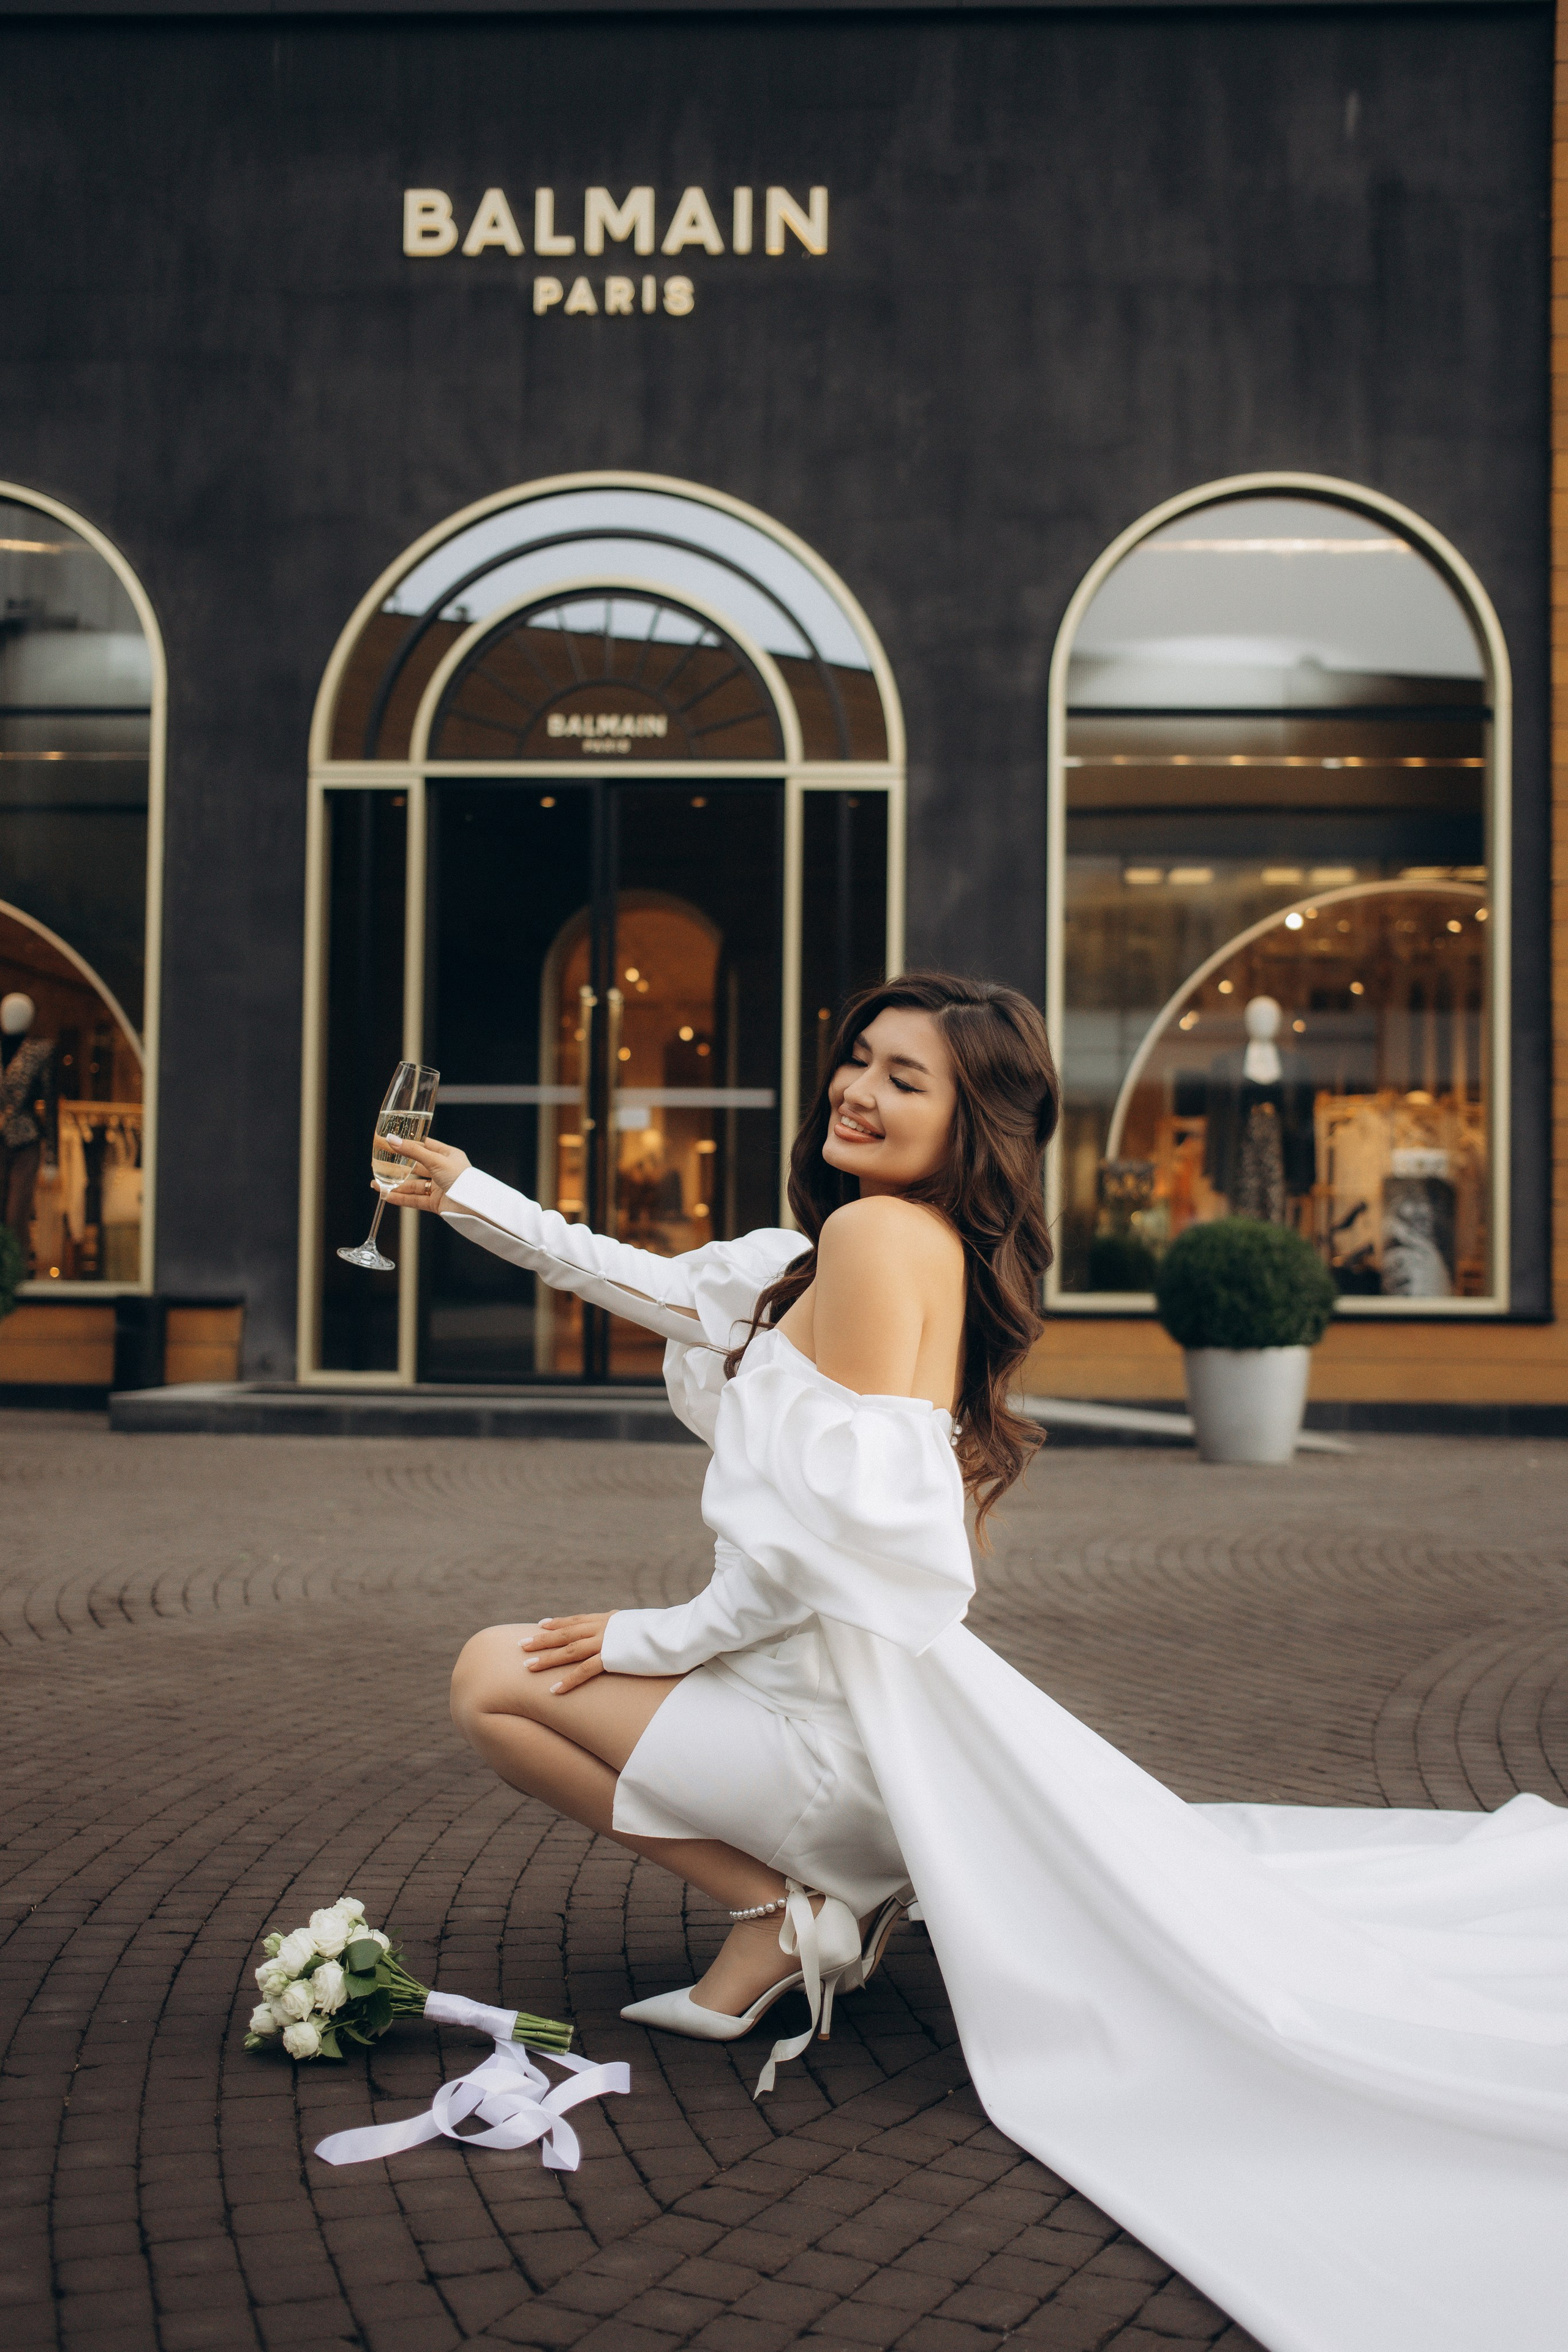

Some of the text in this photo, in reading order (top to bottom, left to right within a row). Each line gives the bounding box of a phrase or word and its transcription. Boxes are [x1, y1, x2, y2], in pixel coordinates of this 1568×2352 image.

[403, 186, 829, 257] BALMAIN
[532, 275, 695, 316] PARIS
[547, 714, 668, 737] BALMAIN
